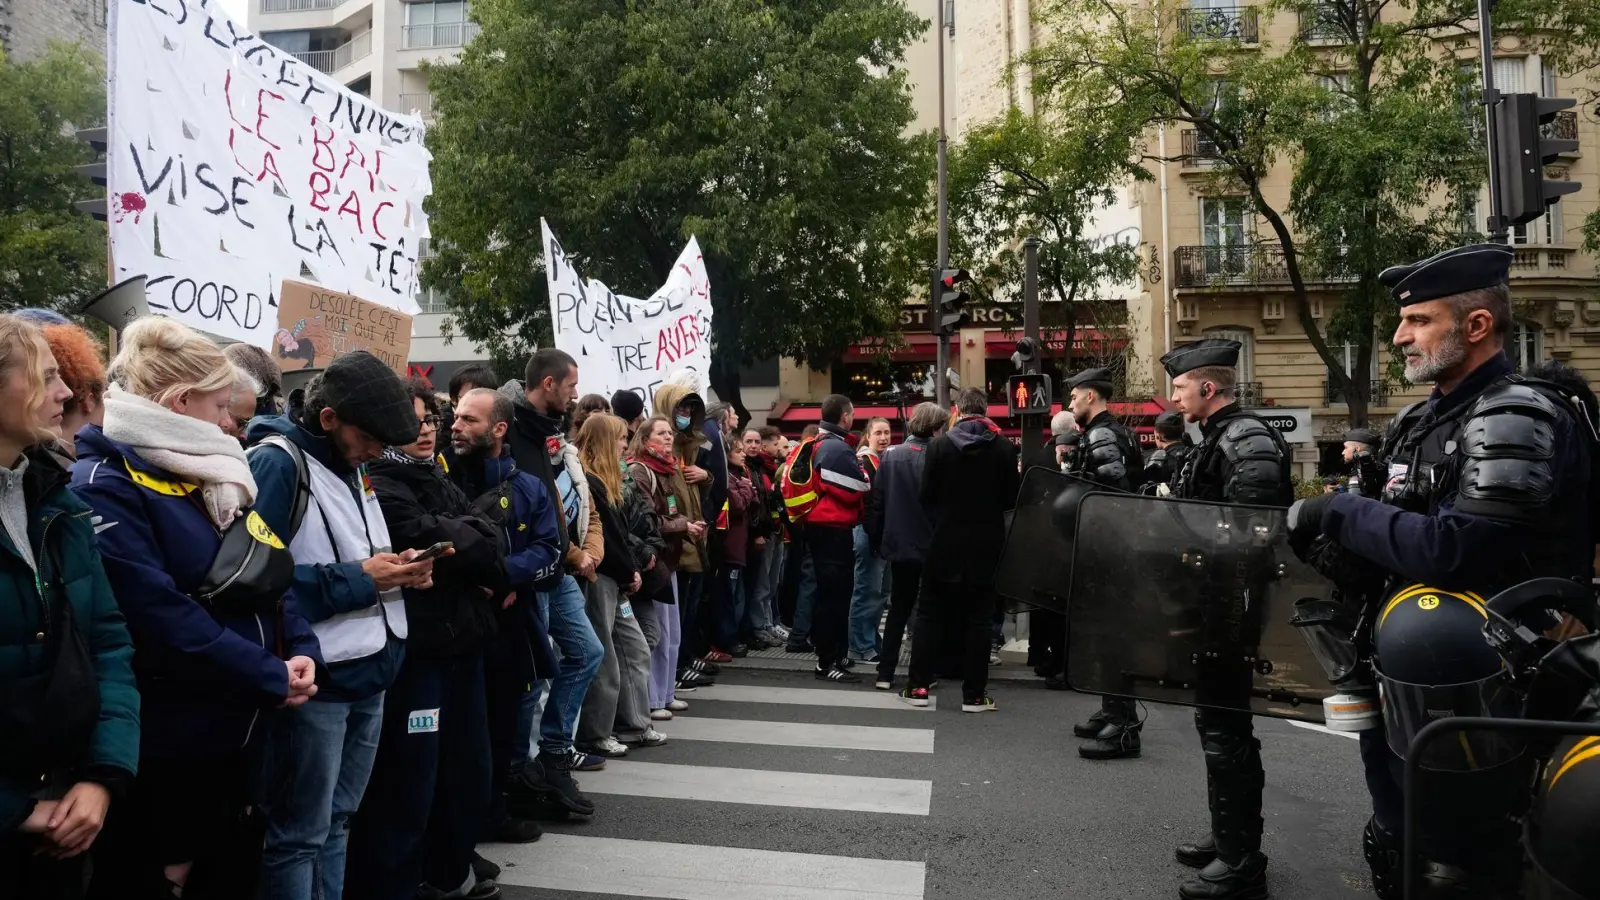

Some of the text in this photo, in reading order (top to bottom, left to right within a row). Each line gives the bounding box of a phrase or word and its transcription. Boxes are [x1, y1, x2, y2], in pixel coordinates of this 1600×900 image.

[324, 314, 349, 333] MOI
[354, 322, 376, 341] QUI
[383, 330, 397, 347] AI
